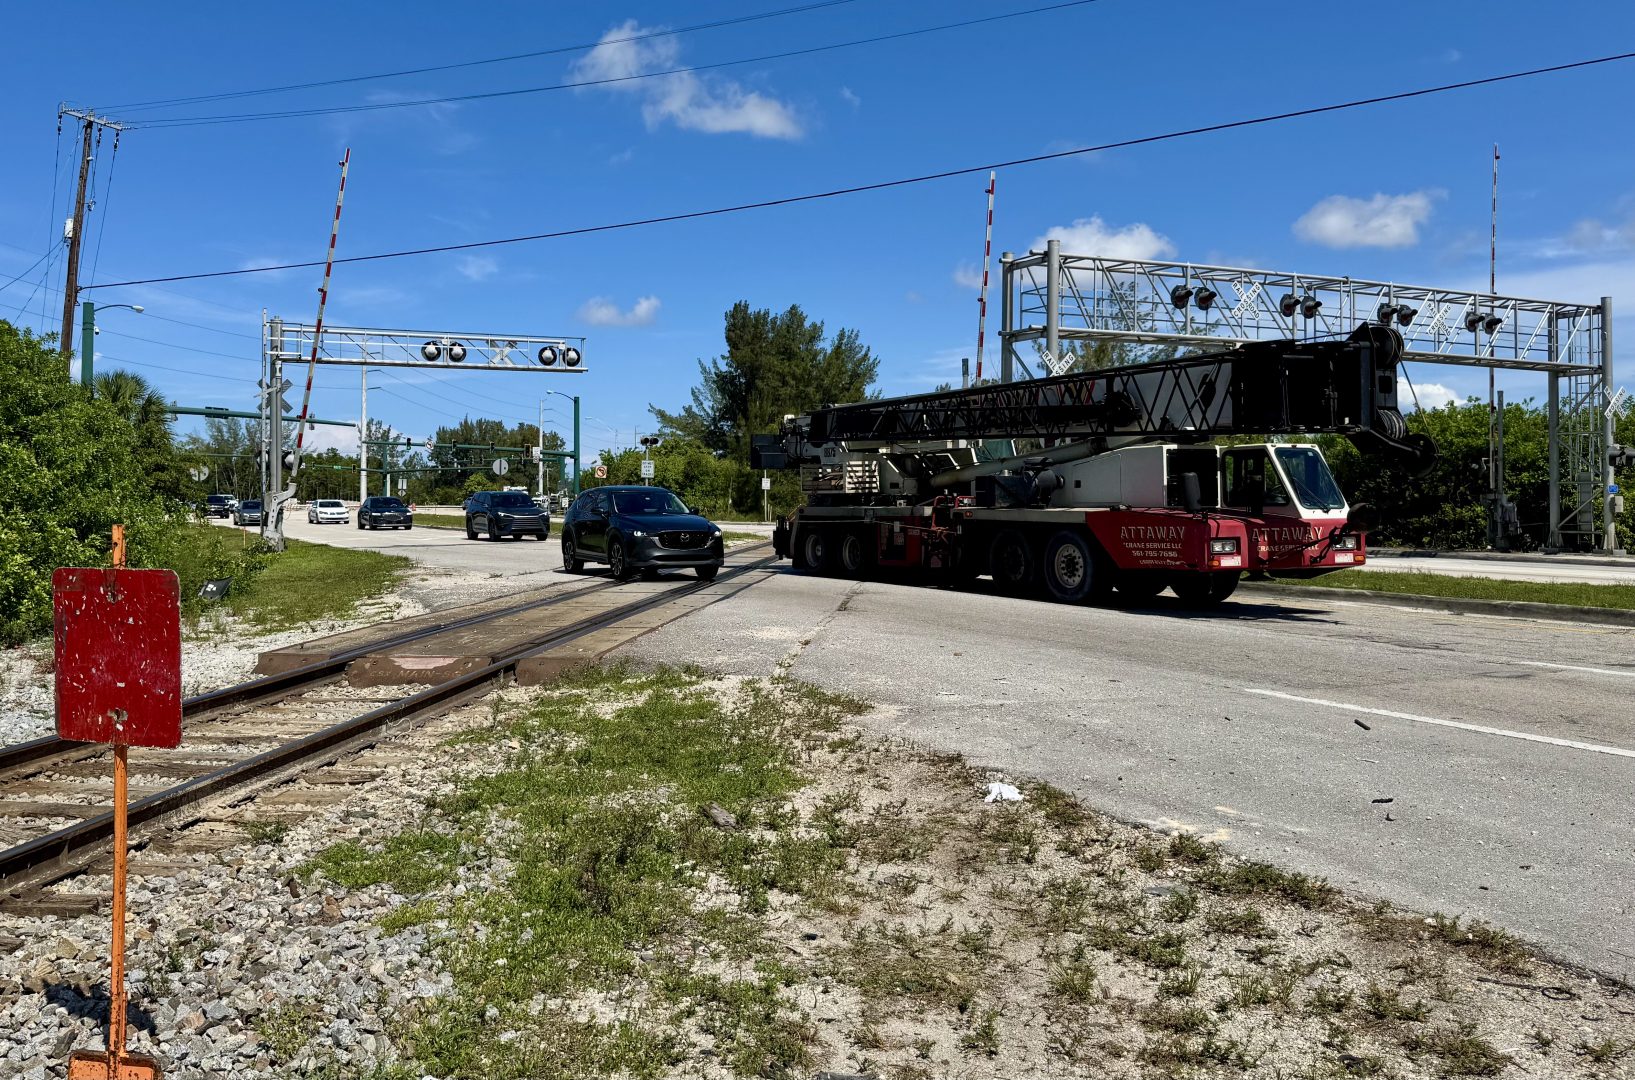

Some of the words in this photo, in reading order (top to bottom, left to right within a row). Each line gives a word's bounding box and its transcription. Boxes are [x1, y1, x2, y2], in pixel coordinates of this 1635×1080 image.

[1233, 282, 1244, 299] RAIL
[1248, 302, 1260, 319] ROAD
[1233, 284, 1260, 317] CROSSING
[1427, 303, 1437, 318] RAIL
[1440, 321, 1451, 337] ROAD
[1428, 304, 1451, 335] CROSSING
[1043, 352, 1057, 371] RAIL
[1605, 389, 1626, 418] CROSSING
[1120, 526, 1185, 540] ATTAWAY
[1251, 526, 1323, 542] ATTAWAY
